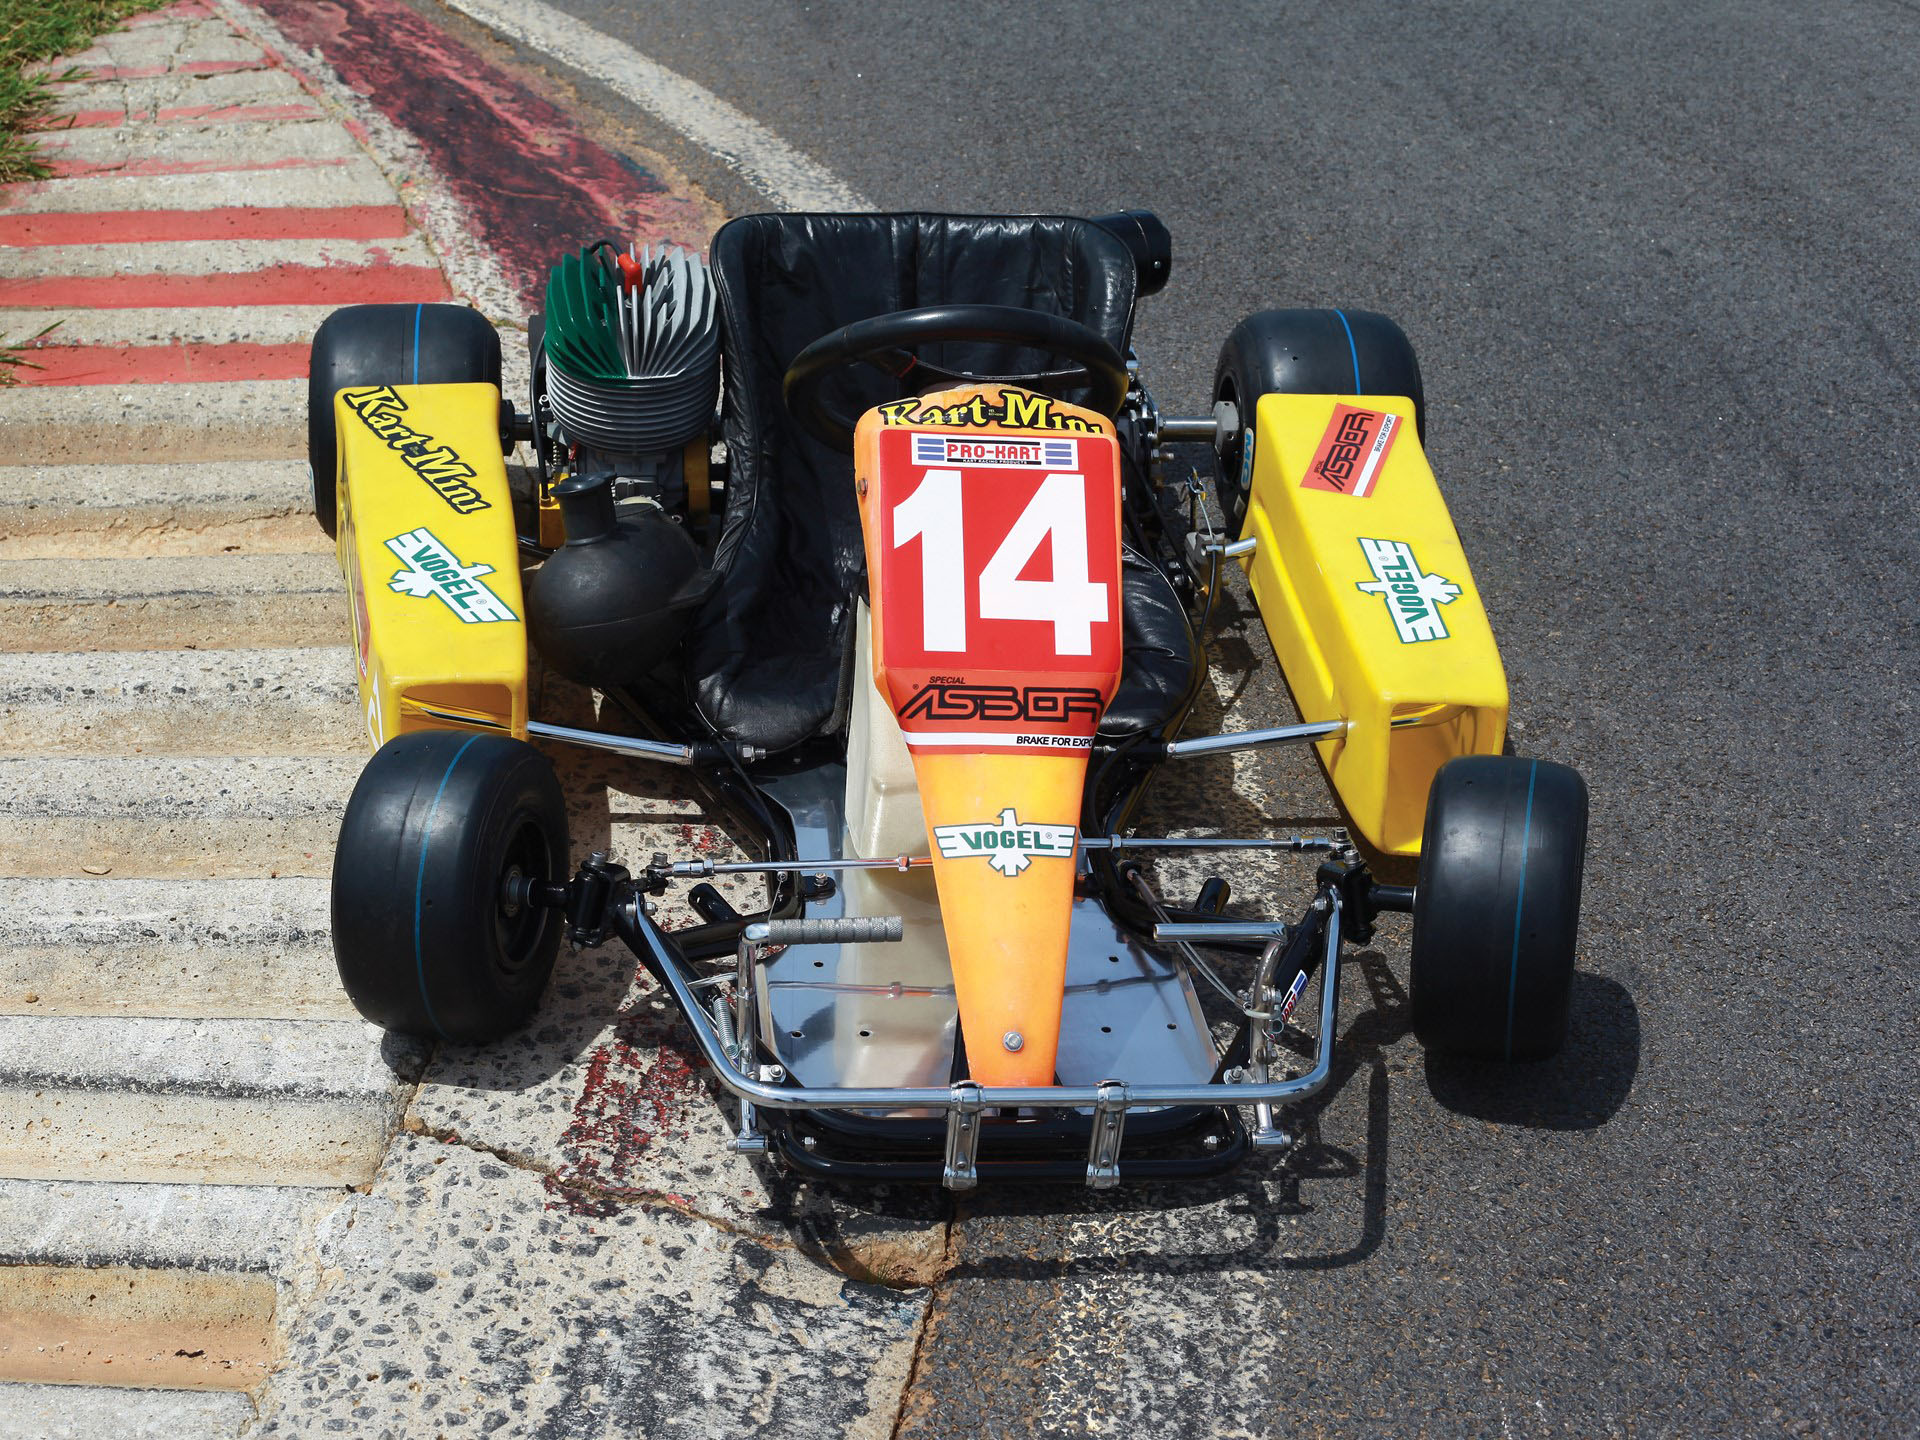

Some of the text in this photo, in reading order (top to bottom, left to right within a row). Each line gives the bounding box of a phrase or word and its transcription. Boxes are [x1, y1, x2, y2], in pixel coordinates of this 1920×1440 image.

[947, 444, 1041, 460] PRO-KART
[893, 469, 1109, 656] 14
[411, 545, 479, 610] VOGEL
[1382, 554, 1429, 624] VOGEL
[929, 676, 966, 685] SPECIAL
[1016, 736, 1049, 745] BRAKE
[1051, 737, 1071, 746] FOR
[960, 831, 1055, 850] VOGEL
